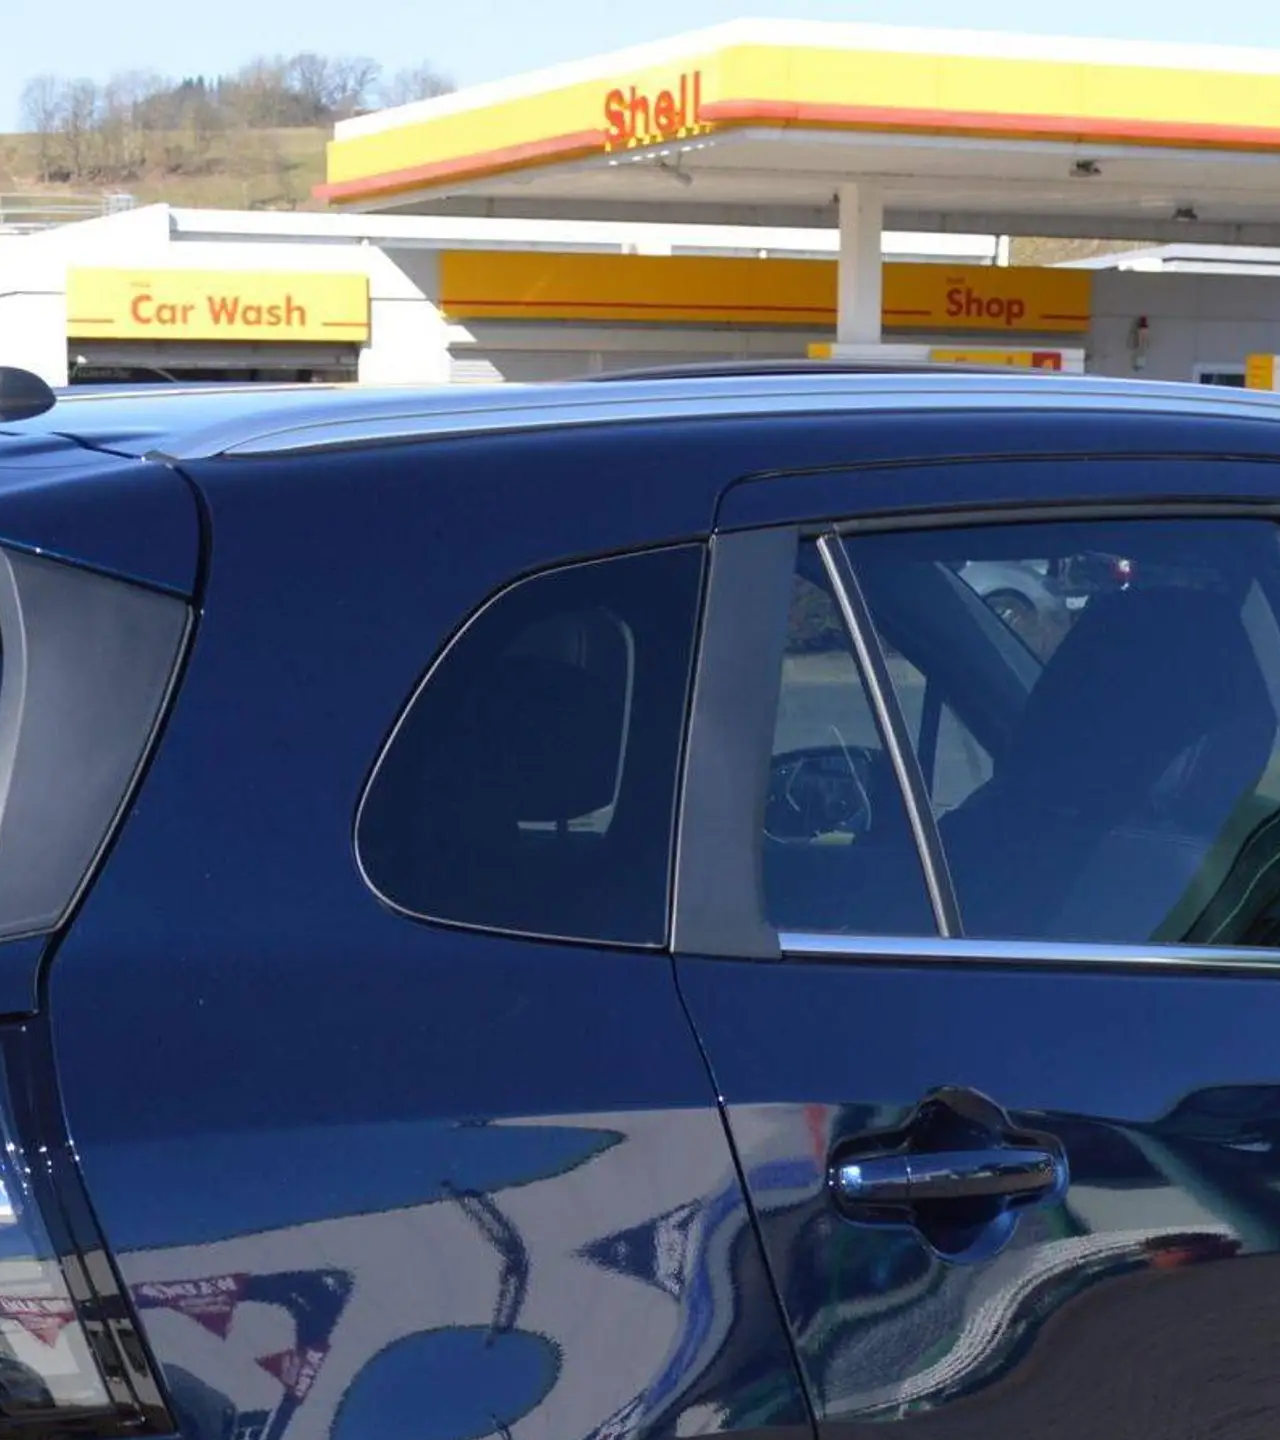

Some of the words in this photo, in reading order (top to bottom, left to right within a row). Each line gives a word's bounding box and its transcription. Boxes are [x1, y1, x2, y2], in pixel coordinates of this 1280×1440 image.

[605, 71, 701, 145] Shell
[130, 294, 195, 325] Car
[206, 294, 307, 327] Wash
[946, 287, 1025, 325] Shop
